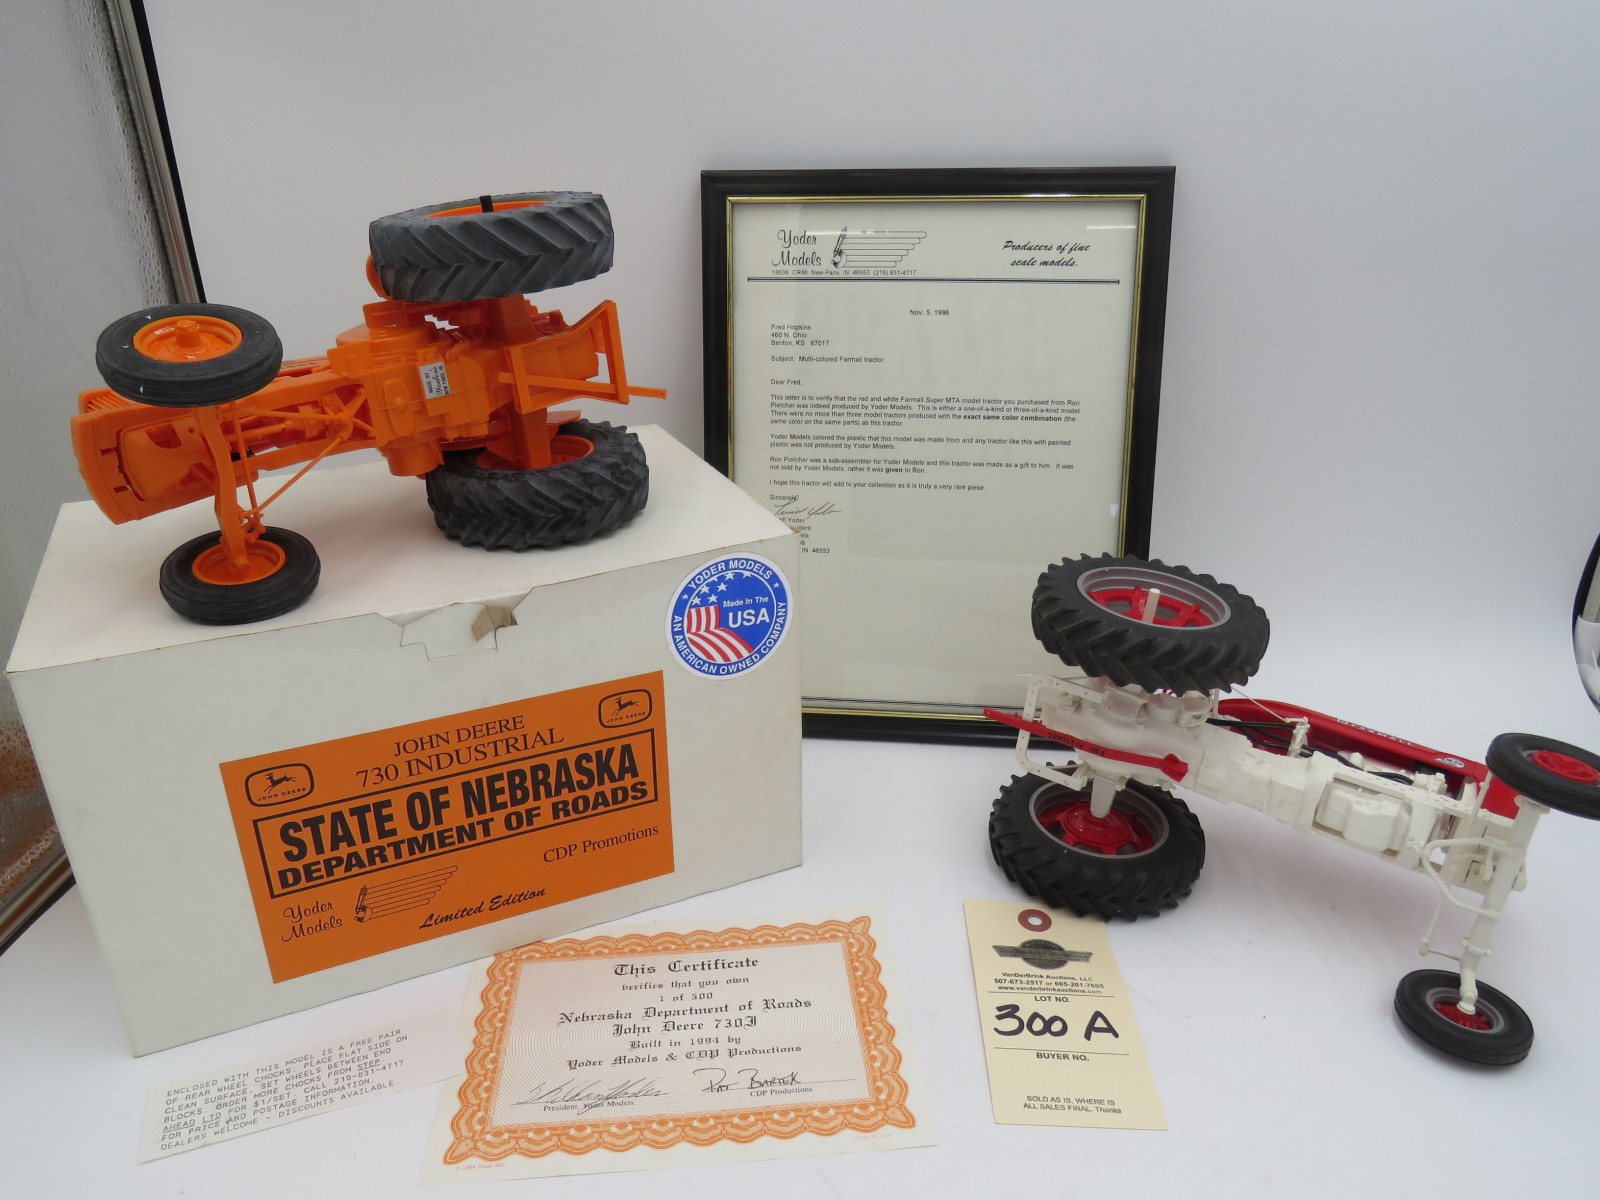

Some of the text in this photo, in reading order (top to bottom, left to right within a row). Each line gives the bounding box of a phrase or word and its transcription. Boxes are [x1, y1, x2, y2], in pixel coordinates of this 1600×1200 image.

[777, 230, 817, 248] Yoder
[1002, 241, 1090, 254] Producers of fine
[772, 251, 821, 266] Models
[1011, 257, 1078, 267] scale models.
[688, 560, 772, 589] YODER MODELS
[723, 599, 743, 607] Made
[729, 608, 769, 628] USA
[674, 602, 786, 674] AN AMERICAN OWNED COMPANY
[606, 716, 623, 724] JOHN
[395, 716, 525, 757] JOHN DEERE
[1351, 723, 1414, 747] FARMALL
[356, 728, 564, 787] 730 INDUSTRIAL
[258, 787, 306, 801] JOHN DEERE
[280, 744, 639, 862] STATE OF NEBRASKA
[278, 781, 648, 890] DEPARTMENT OF ROADS
[544, 825, 659, 862] CDP Promotions
[283, 901, 333, 923] Yoder
[419, 888, 546, 929] Limited Edition
[282, 916, 343, 942] Models
[614, 957, 758, 977] This Certificate
[622, 983, 663, 991] verifies
[671, 981, 691, 990] that
[699, 979, 719, 988] you
[998, 986, 1102, 994] www.vanderbrinkauctions.com
[558, 998, 811, 1026] Nebraska Department of Roads
[994, 1004, 1119, 1041] 300 A
[612, 1023, 651, 1036] John
[661, 1020, 704, 1034] Deere
[629, 1040, 661, 1051] Built
[691, 1037, 718, 1045] 1994
[728, 1036, 741, 1044] by
[167, 1080, 218, 1097] ENCLOSED
[224, 1072, 249, 1083] WITH
[256, 1064, 279, 1074] THIS
[285, 1054, 314, 1066] MODEL
[322, 1048, 332, 1056] IS
[350, 1038, 372, 1048] FREE
[378, 1029, 400, 1040] PAIR
[567, 1046, 801, 1070] Yoder Models & CDP Productions
[1036, 1052, 1070, 1060] BUYER
[165, 1101, 197, 1114] CLEAN
[261, 1079, 279, 1089] SET
[286, 1068, 321, 1082] WHEELS
[328, 1054, 368, 1070] BETWEEN
[374, 1048, 391, 1057] END
[166, 1035, 408, 1106] OF REAR WHEEL CHOCKS. PLACE FLAT SIDE ON
[164, 1059, 380, 1123] BLOCKS. ORDER MORE CHOCKS FROM STEP
[750, 1087, 813, 1097] CDP Productions
[160, 1080, 399, 1151] DEALERS WELCOME DISCOUNTS AVAILABLE.
[161, 1078, 374, 1141] FOR PRICE AND POSTAGE INFORMATION.
[163, 1119, 195, 1133] AHEAD
[202, 1112, 221, 1123] LTD
[228, 1105, 247, 1115] FOR
[253, 1092, 296, 1108] $1/SET.
[304, 1082, 327, 1093] CALL
[543, 1104, 579, 1112] President,
